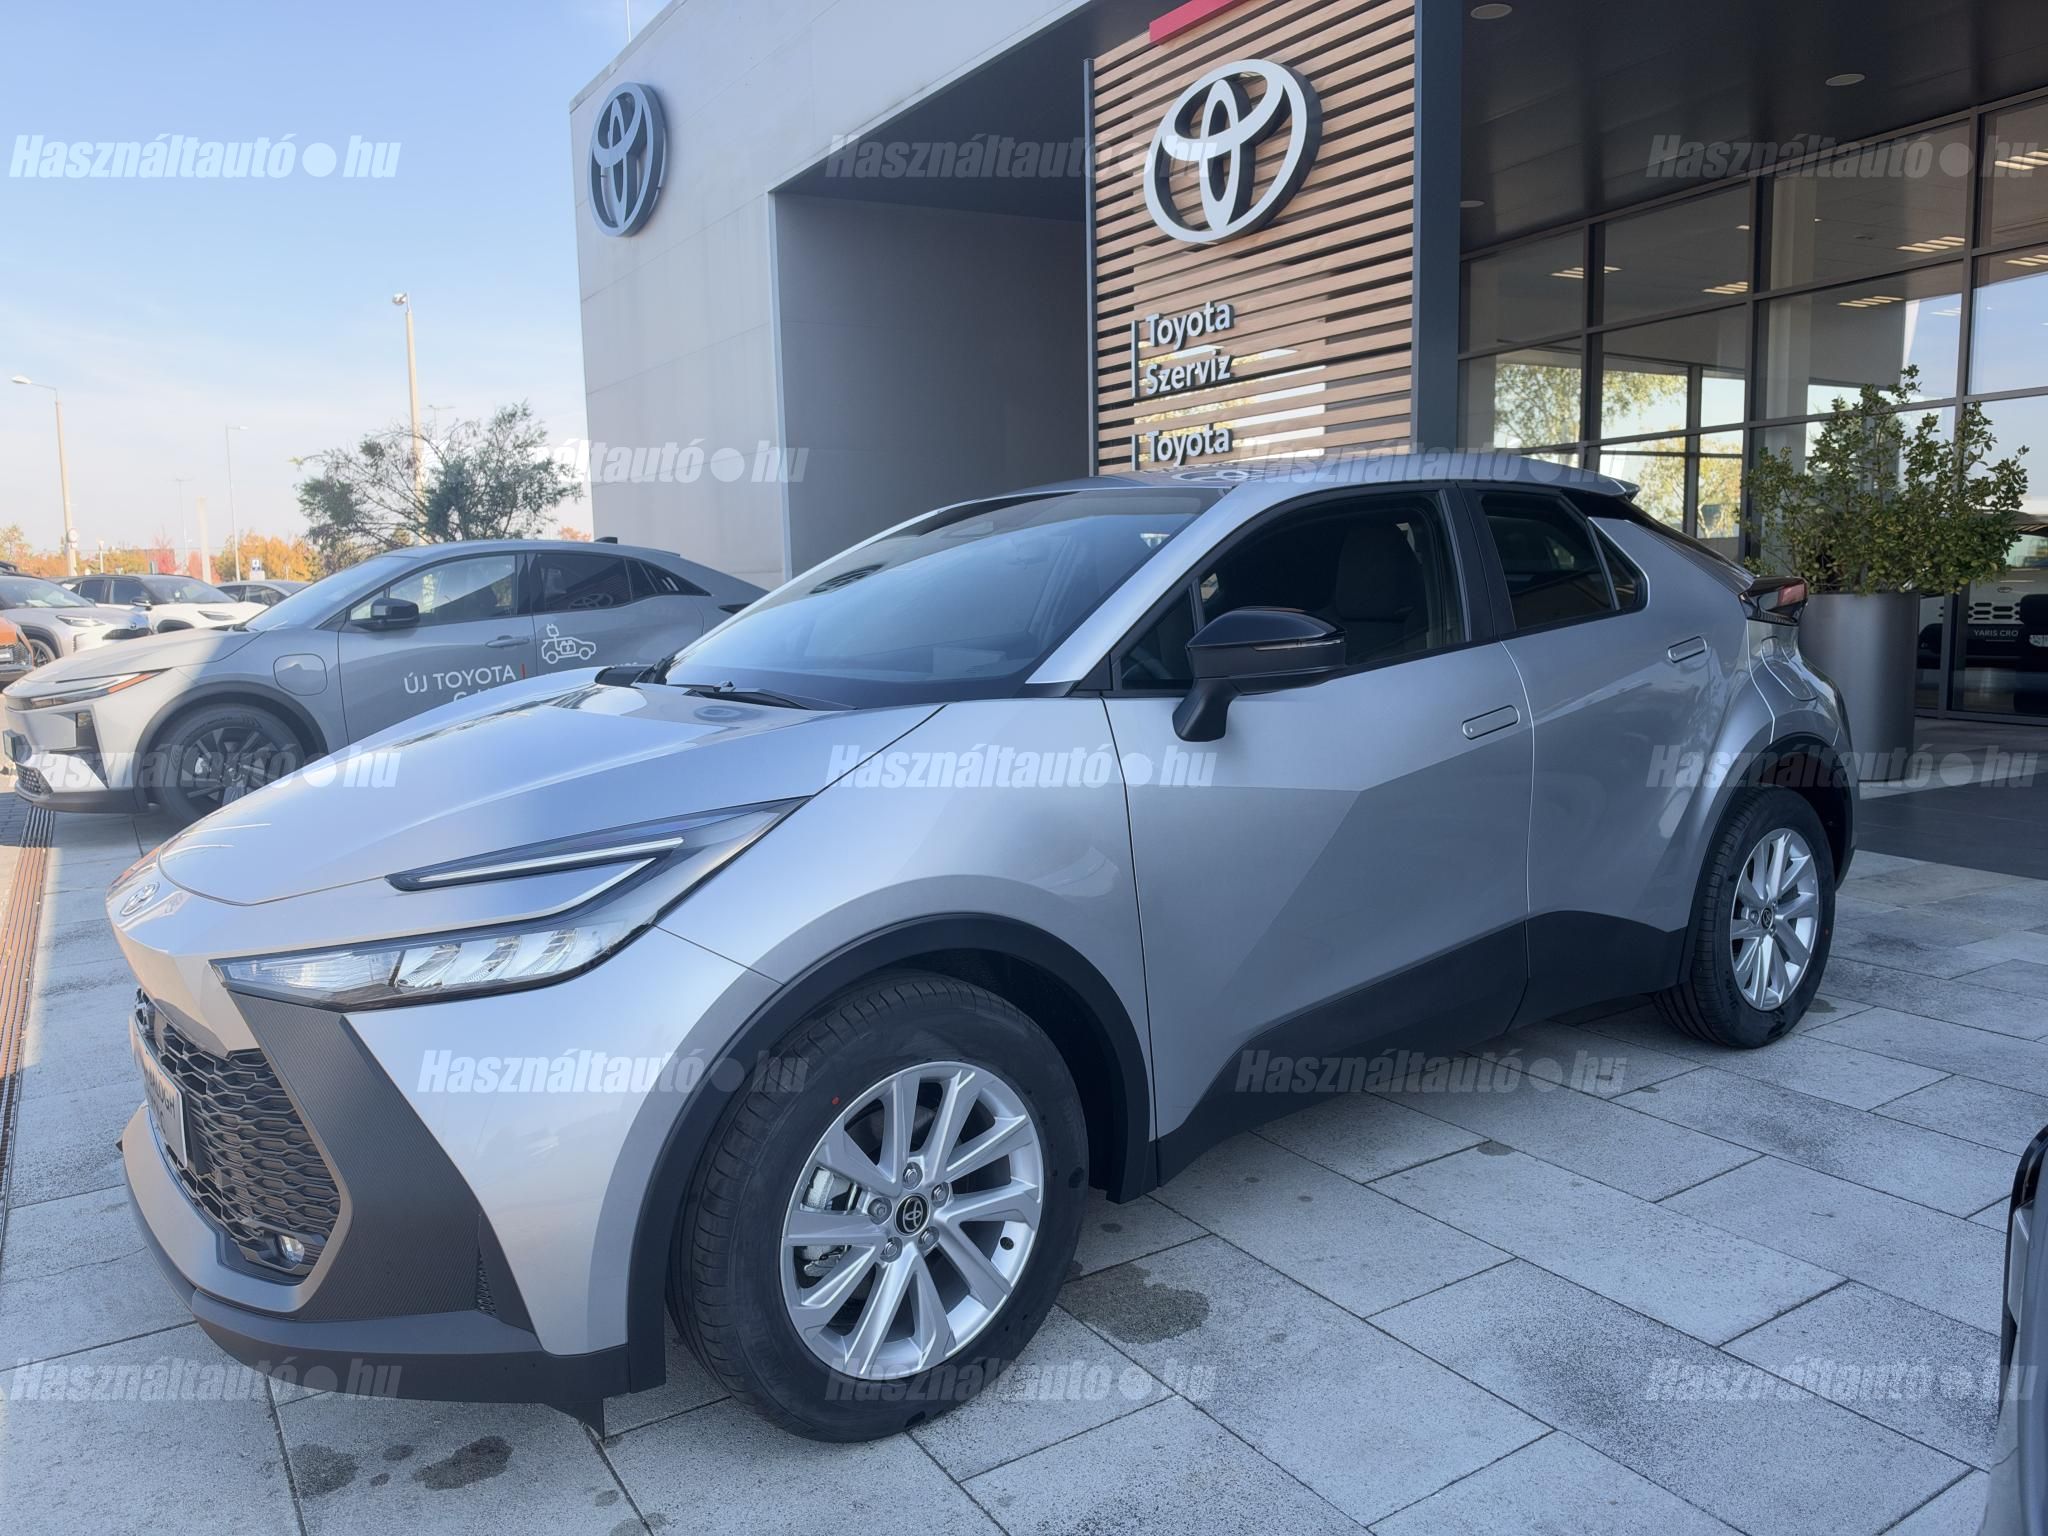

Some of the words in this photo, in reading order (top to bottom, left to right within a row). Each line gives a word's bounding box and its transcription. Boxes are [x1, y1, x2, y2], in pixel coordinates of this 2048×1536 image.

[1145, 301, 1233, 350] Toyota
[1145, 349, 1232, 395] Szerviz
[1145, 423, 1232, 467] Toyota
[1974, 629, 1998, 637] YARIS
[1999, 629, 2019, 637] CRO
[404, 672, 427, 694] ÚJ
[433, 664, 516, 690] TOYOTA
